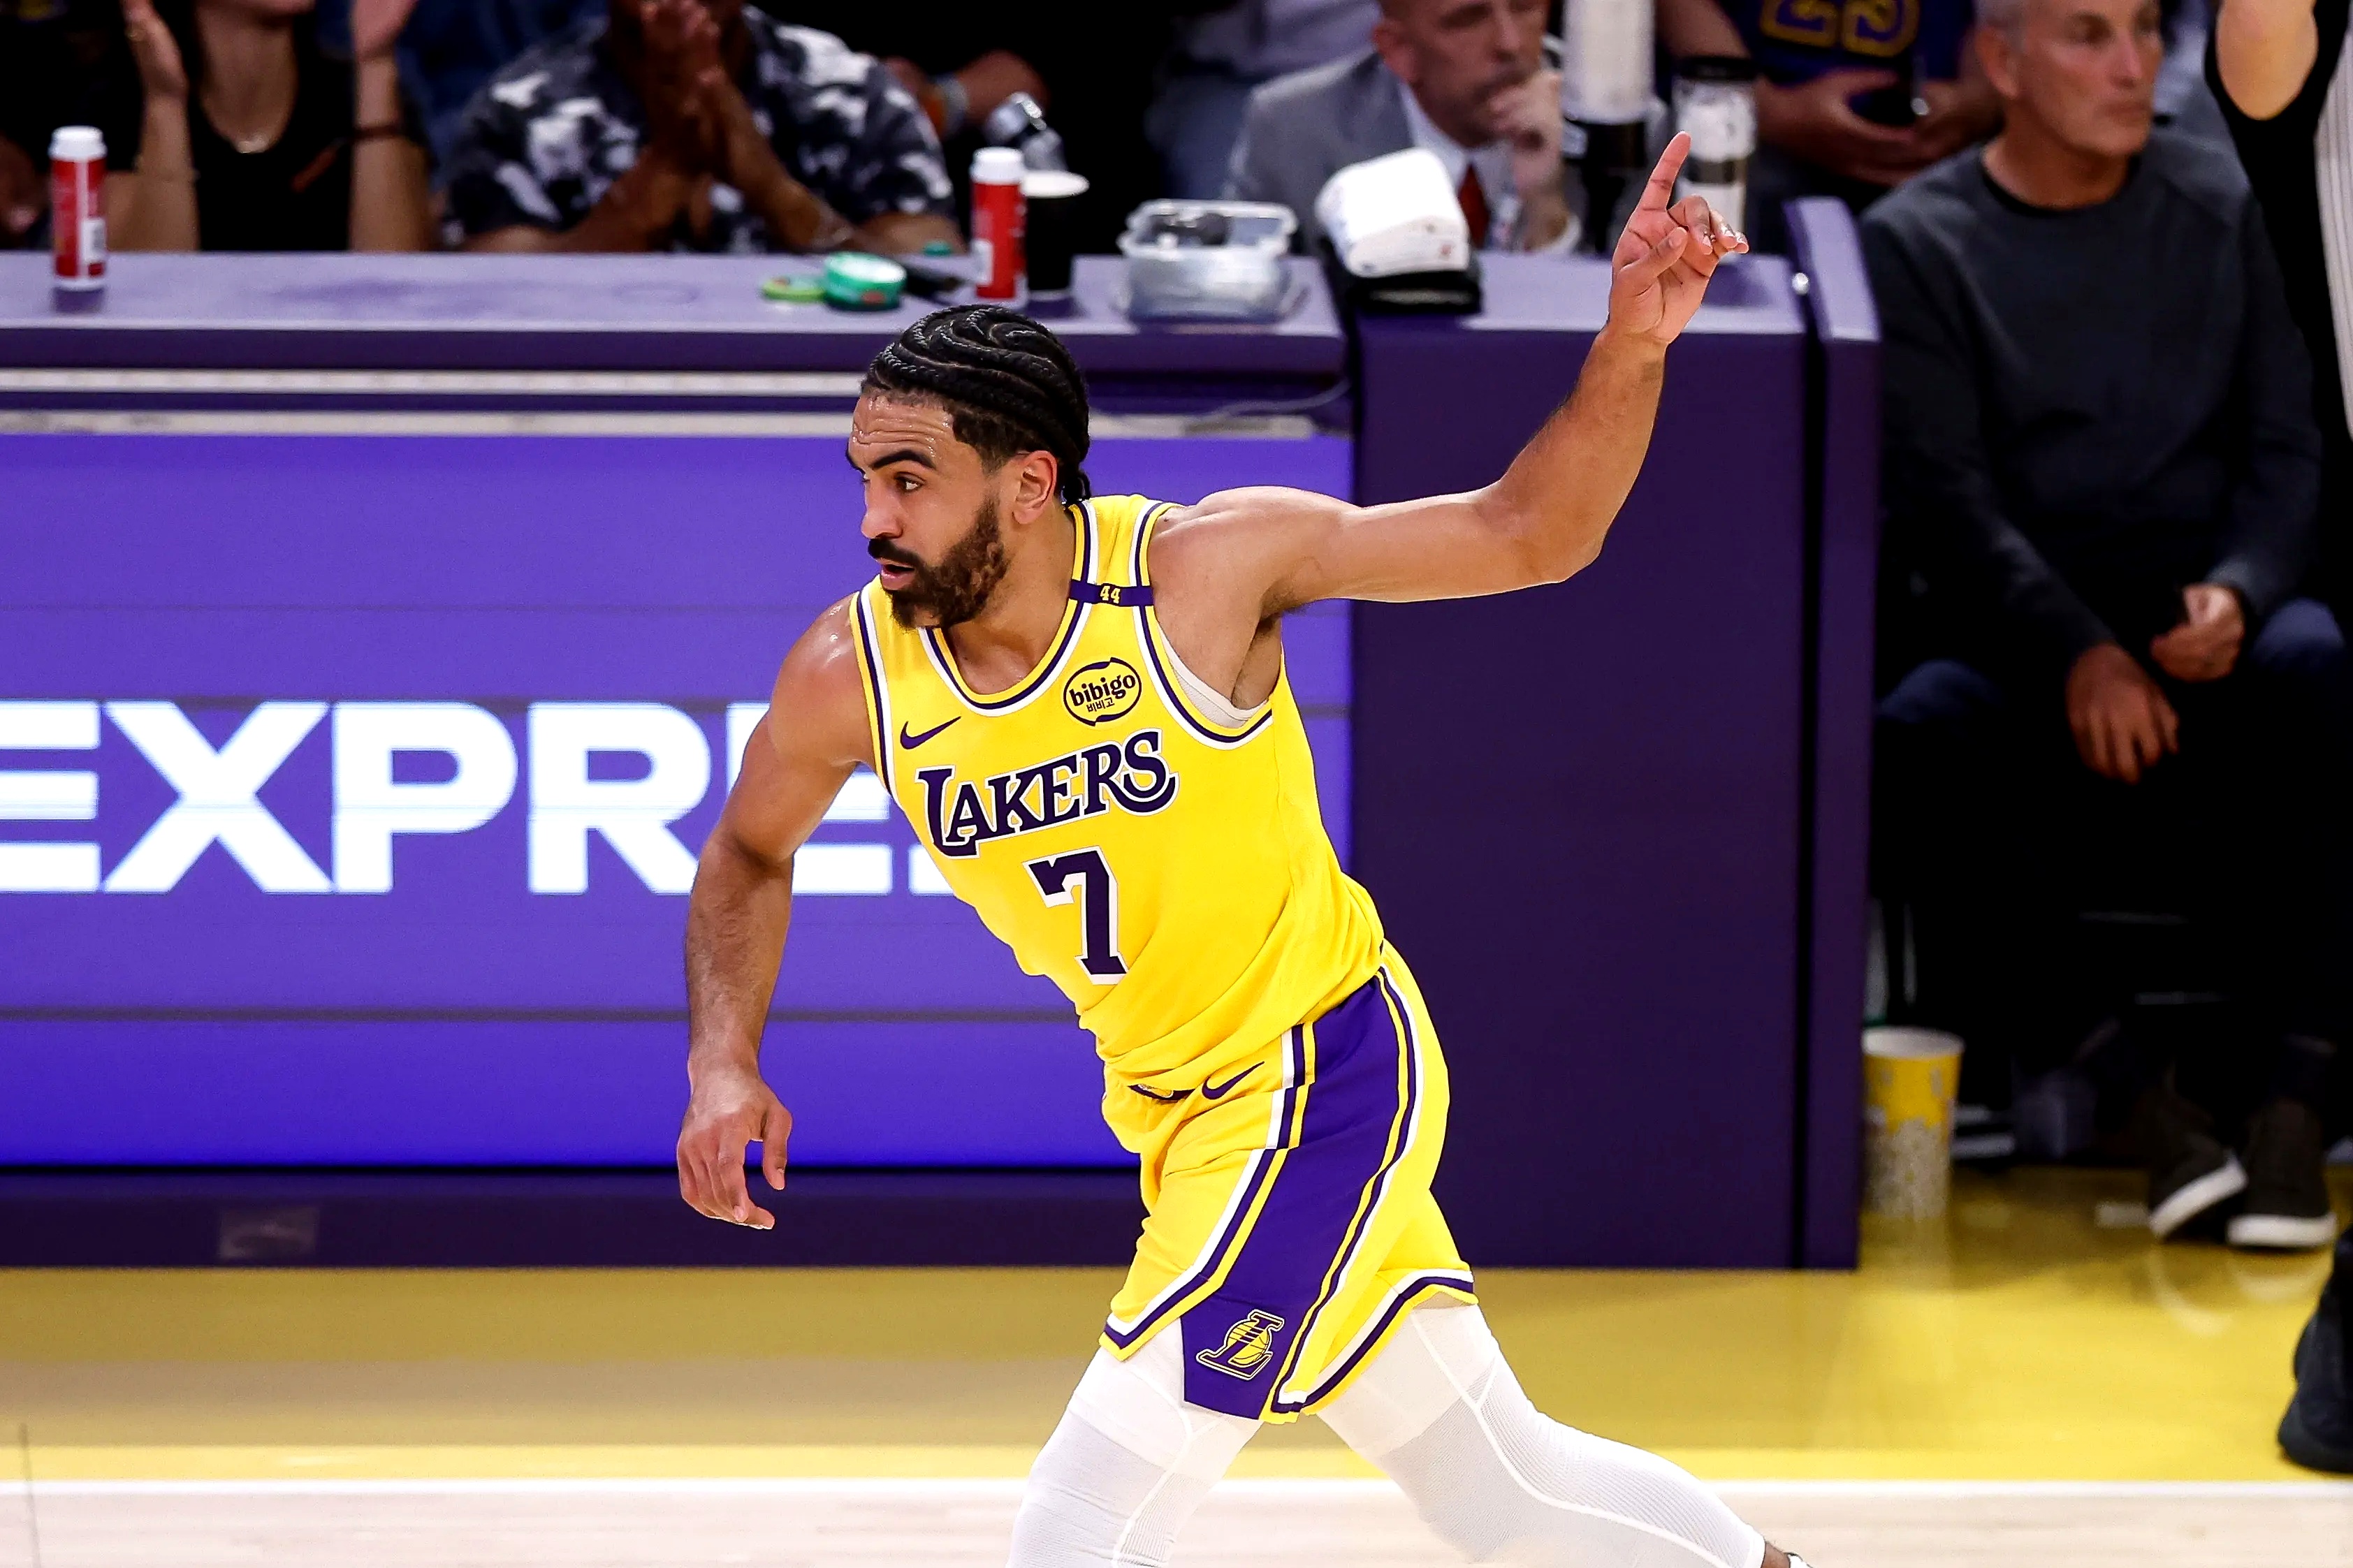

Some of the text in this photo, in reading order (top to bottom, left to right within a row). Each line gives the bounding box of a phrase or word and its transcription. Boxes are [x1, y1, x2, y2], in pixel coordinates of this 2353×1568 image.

[1100, 585, 1121, 604] 44
[1069, 675, 1136, 707] bibigo
[1086, 697, 1115, 712] 비비고
[0, 701, 954, 895] EXPR
[915, 728, 1179, 858] LAKERS
[1023, 846, 1128, 985] 7
